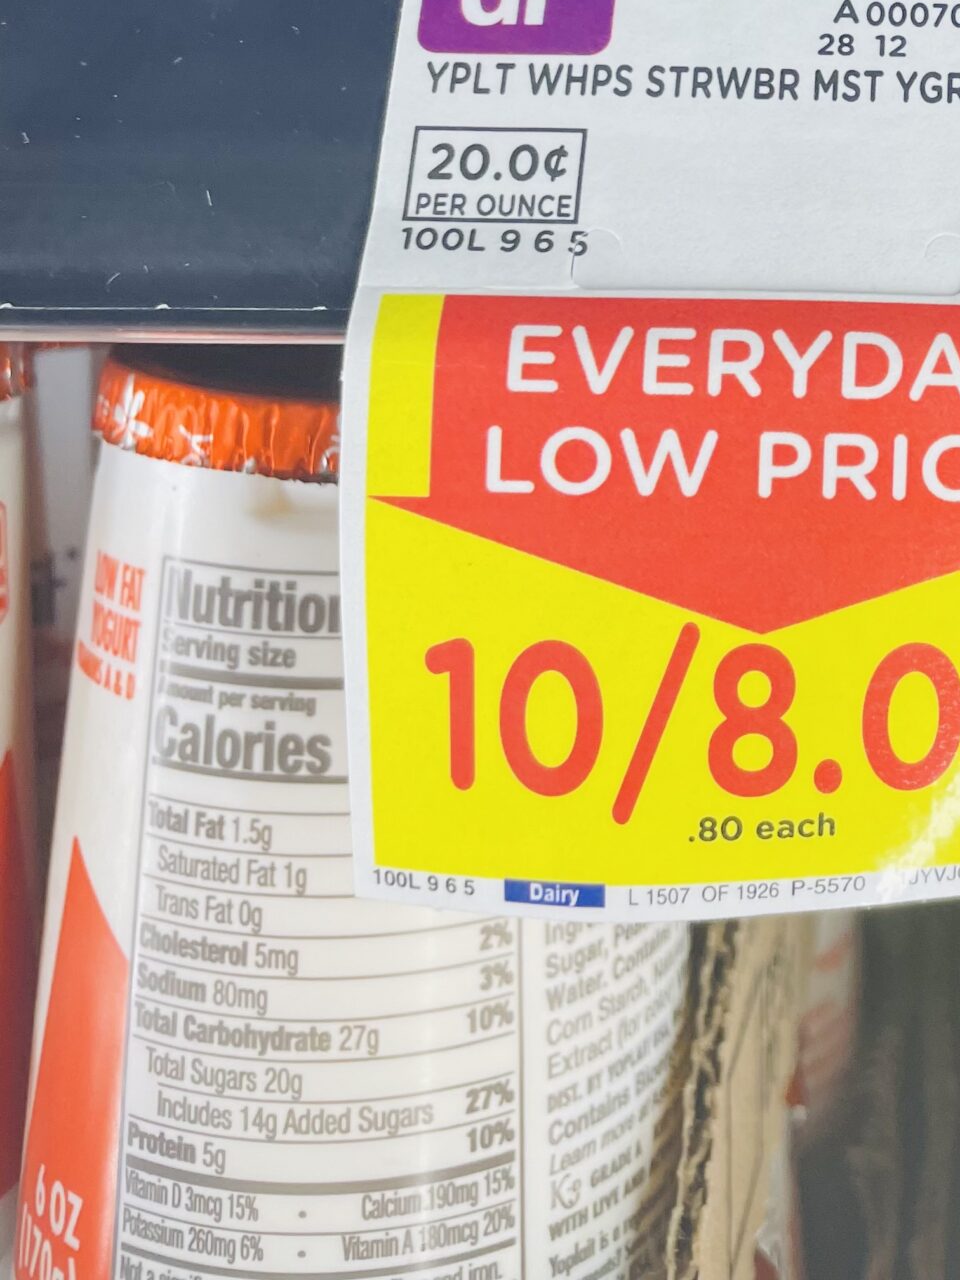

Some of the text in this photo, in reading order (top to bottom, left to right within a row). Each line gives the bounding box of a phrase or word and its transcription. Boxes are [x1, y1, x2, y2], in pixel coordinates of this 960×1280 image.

[817, 33, 855, 56] 28
[876, 34, 907, 58] 12
[427, 61, 515, 95] YPLT
[528, 63, 633, 98] WHPS
[645, 65, 800, 101] STRWBR
[813, 69, 884, 103] MST
[427, 142, 570, 182] 20.0¢
[415, 193, 573, 218] PER OUNCE
[500, 229, 521, 253] 9
[533, 230, 555, 253] 6
[568, 230, 589, 257] 5
[485, 426, 719, 497] LOW
[162, 625, 298, 670] Serving size
[218, 688, 244, 710] per
[250, 687, 317, 718] serving
[154, 704, 334, 776] Calories
[147, 800, 274, 852] Total Fat 1.5g
[687, 812, 837, 844] .80 each
[158, 844, 308, 896] Saturated Fat 1g
[372, 869, 476, 896] 100L 9 6 5
[528, 883, 580, 907] Dairy
[628, 888, 639, 906] L
[646, 887, 691, 906] 1507
[701, 884, 730, 903] OF
[737, 882, 780, 900] 1926
[791, 875, 867, 897] P-5570
[155, 883, 264, 936] Trans Fat 0g
[139, 920, 249, 968] Cholesterol
[254, 942, 300, 978] 5mg
[479, 919, 514, 952] 2%
[136, 960, 514, 1016] Sodium 80mg 3%
[134, 999, 514, 1057] Total Carbohydrate 27g 10%
[546, 1010, 594, 1046] Corn
[546, 1028, 613, 1080] Extract
[145, 1045, 304, 1102] Total Sugars 20g
[156, 1078, 516, 1141] Includes 14g Added Sugars 27%
[548, 1086, 631, 1147] Contains
[126, 1117, 516, 1176] Protein 5g 10%
[548, 1140, 598, 1177] Learn
[35, 1163, 84, 1253] 6 OZ
[125, 1170, 260, 1224] Vitamin D 3mcg 15%
[361, 1165, 516, 1221] Calcium 190mg 15%
[122, 1206, 264, 1266] Potassium 260mg 6%
[341, 1231, 399, 1262] Vitamin
[402, 1228, 414, 1256] A
[482, 1203, 516, 1238] 20%
[548, 1205, 590, 1243] WITH
